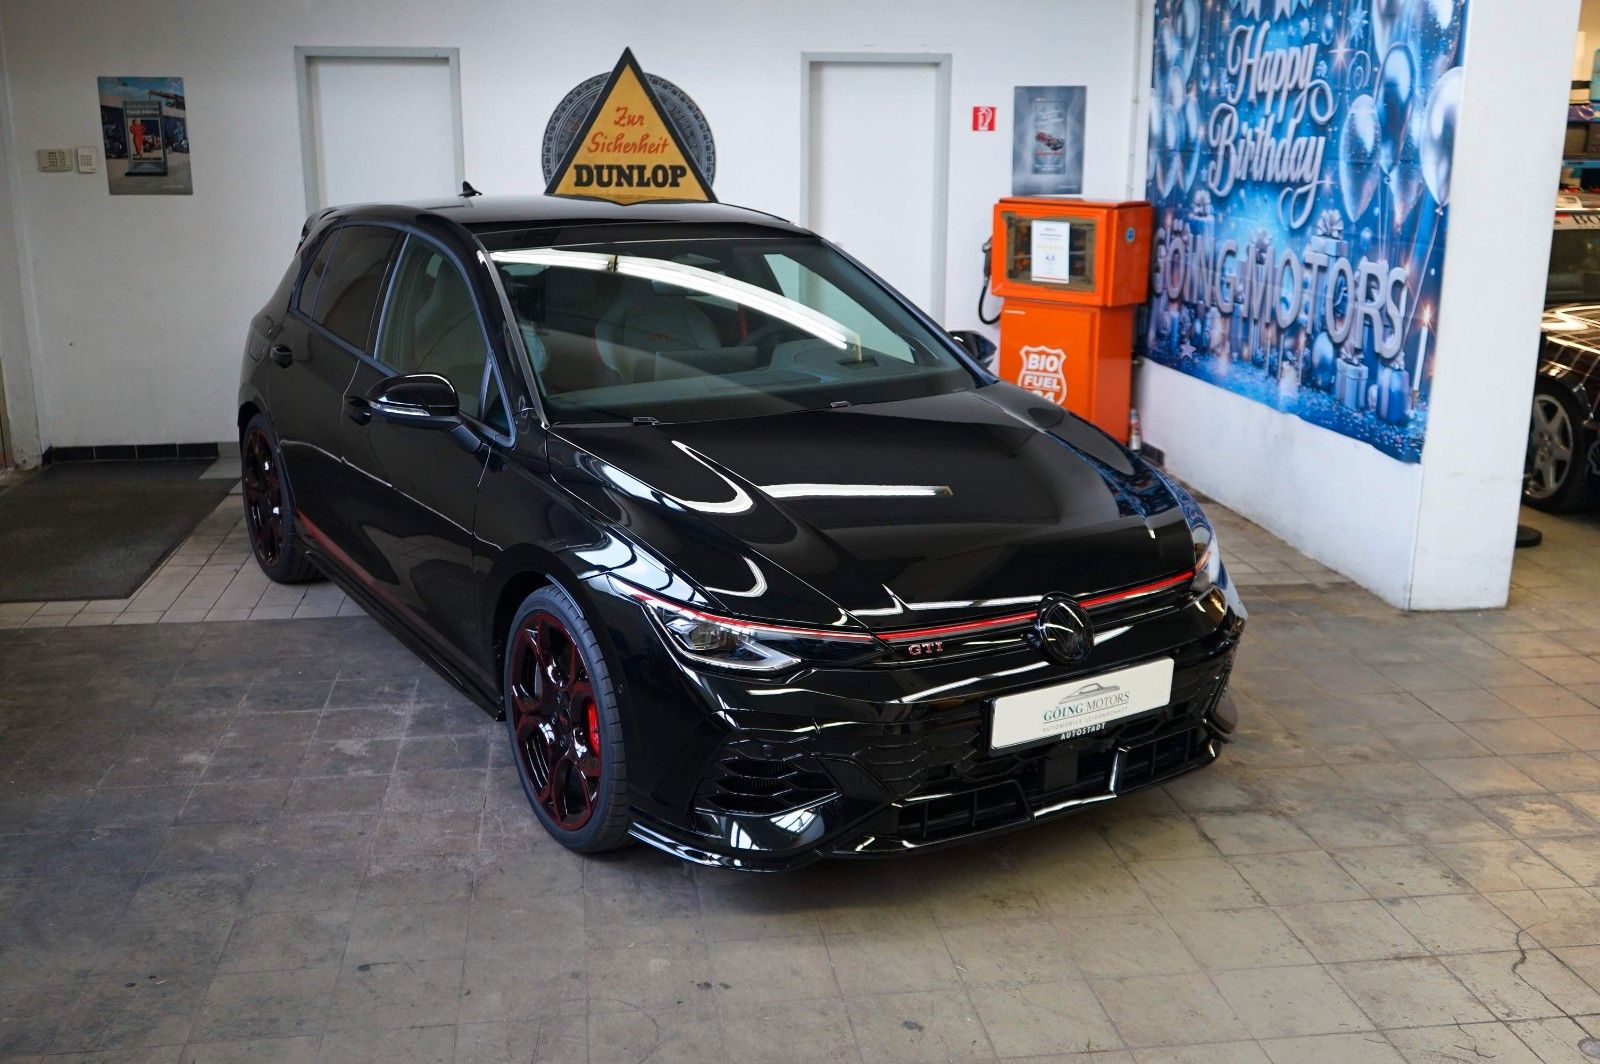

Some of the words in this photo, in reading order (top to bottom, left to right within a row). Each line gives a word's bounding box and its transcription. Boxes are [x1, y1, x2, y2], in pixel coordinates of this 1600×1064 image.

[1227, 21, 1334, 125] Happy
[613, 105, 645, 127] Zur
[587, 131, 669, 154] Sicherheit
[573, 163, 687, 188] DUNLOP
[1207, 102, 1325, 229] Birthday
[1240, 245, 1407, 360] MOTORS
[1028, 353, 1059, 372] BIO
[1023, 375, 1060, 389] FUEL
[908, 641, 944, 656] GTI
[1043, 704, 1084, 722] GÖING
[1086, 690, 1131, 713] MOTORS
[1060, 722, 1106, 741] AUTOSTADT
